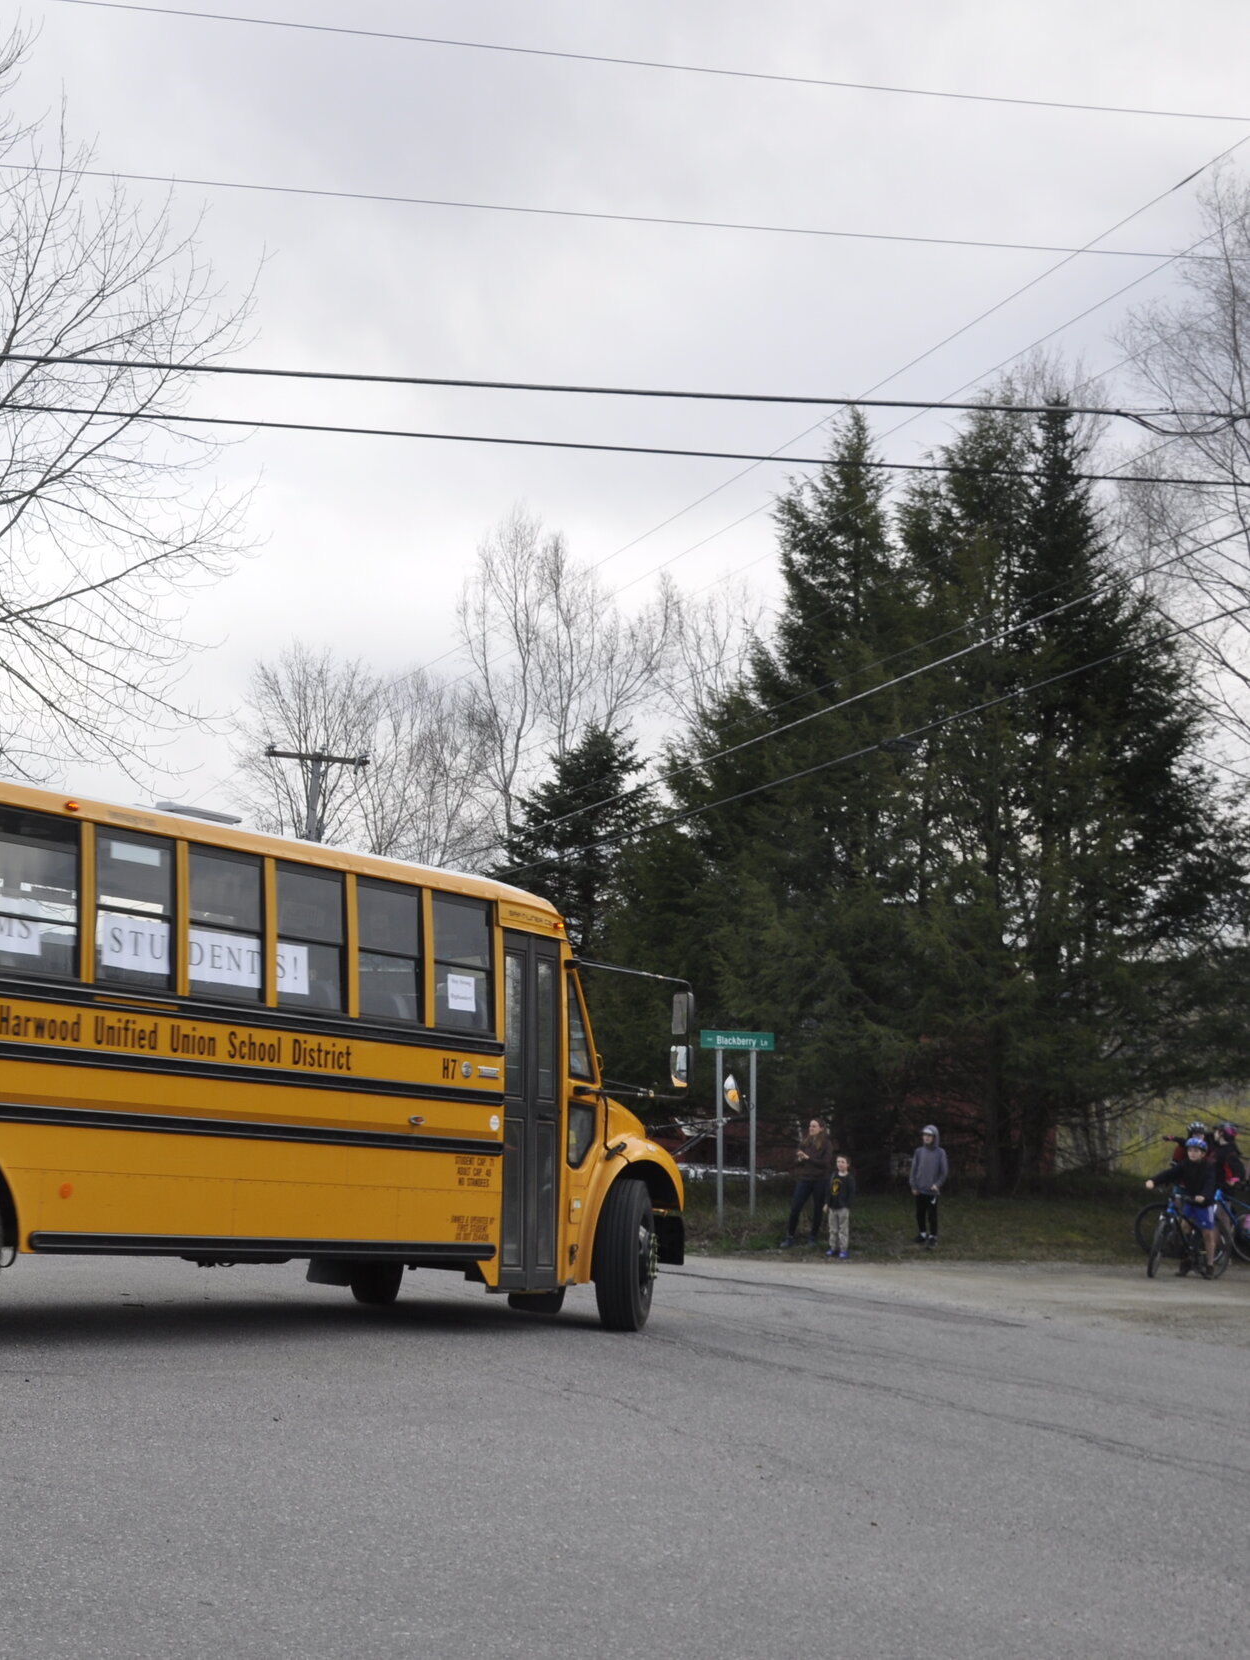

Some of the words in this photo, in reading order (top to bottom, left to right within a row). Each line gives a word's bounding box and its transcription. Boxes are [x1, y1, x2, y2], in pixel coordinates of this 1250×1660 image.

[94, 1015, 159, 1051] Unified
[170, 1023, 217, 1057] Union
[228, 1030, 282, 1064] School
[292, 1038, 353, 1071] District
[716, 1034, 757, 1048] Blackberry
[442, 1057, 457, 1080] H7
[455, 1155, 475, 1166] STUDENT
